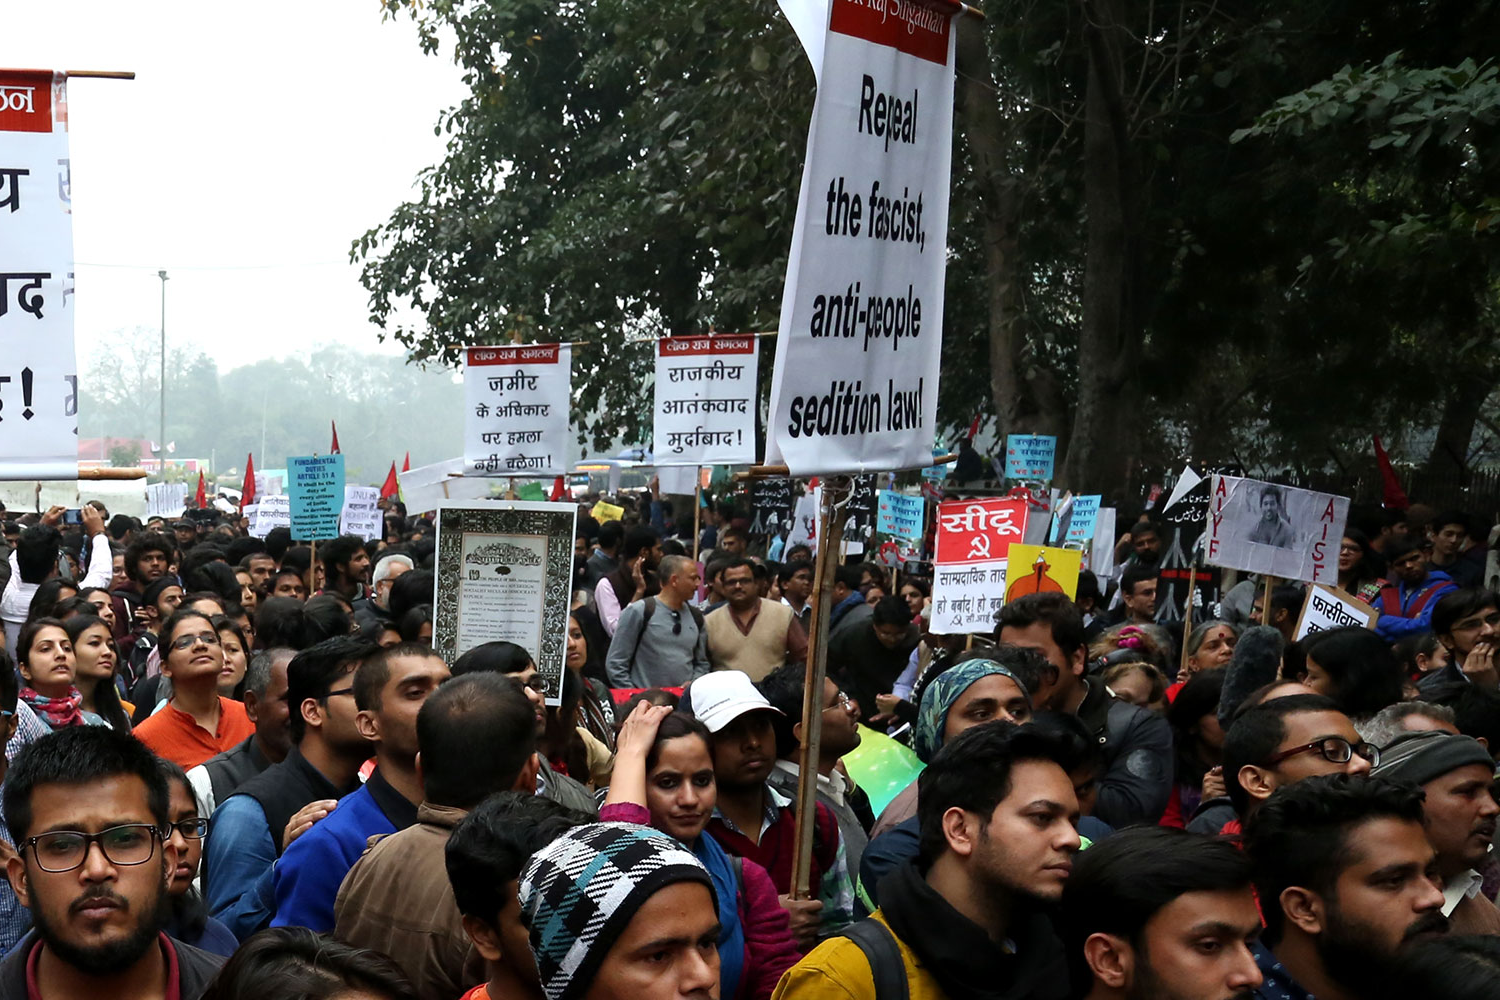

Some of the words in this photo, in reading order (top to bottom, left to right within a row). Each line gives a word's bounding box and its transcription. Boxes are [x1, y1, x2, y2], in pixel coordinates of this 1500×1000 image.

[858, 73, 917, 152] Repeal
[826, 176, 861, 238] the
[868, 180, 925, 254] fascist,
[810, 281, 921, 352] anti-people
[487, 369, 539, 396] ज़मीर
[668, 360, 744, 382] राजकीय
[475, 403, 490, 418] के
[496, 401, 550, 417] अधिकार
[663, 393, 749, 414] आतंकवाद
[788, 380, 881, 439] sedition
[886, 376, 923, 433] law!
[482, 432, 502, 444] पर
[507, 431, 543, 445] हमला
[295, 458, 336, 466] FUNDAMENTAL
[473, 454, 500, 472] नहीं
[940, 505, 1021, 535] सीटू
